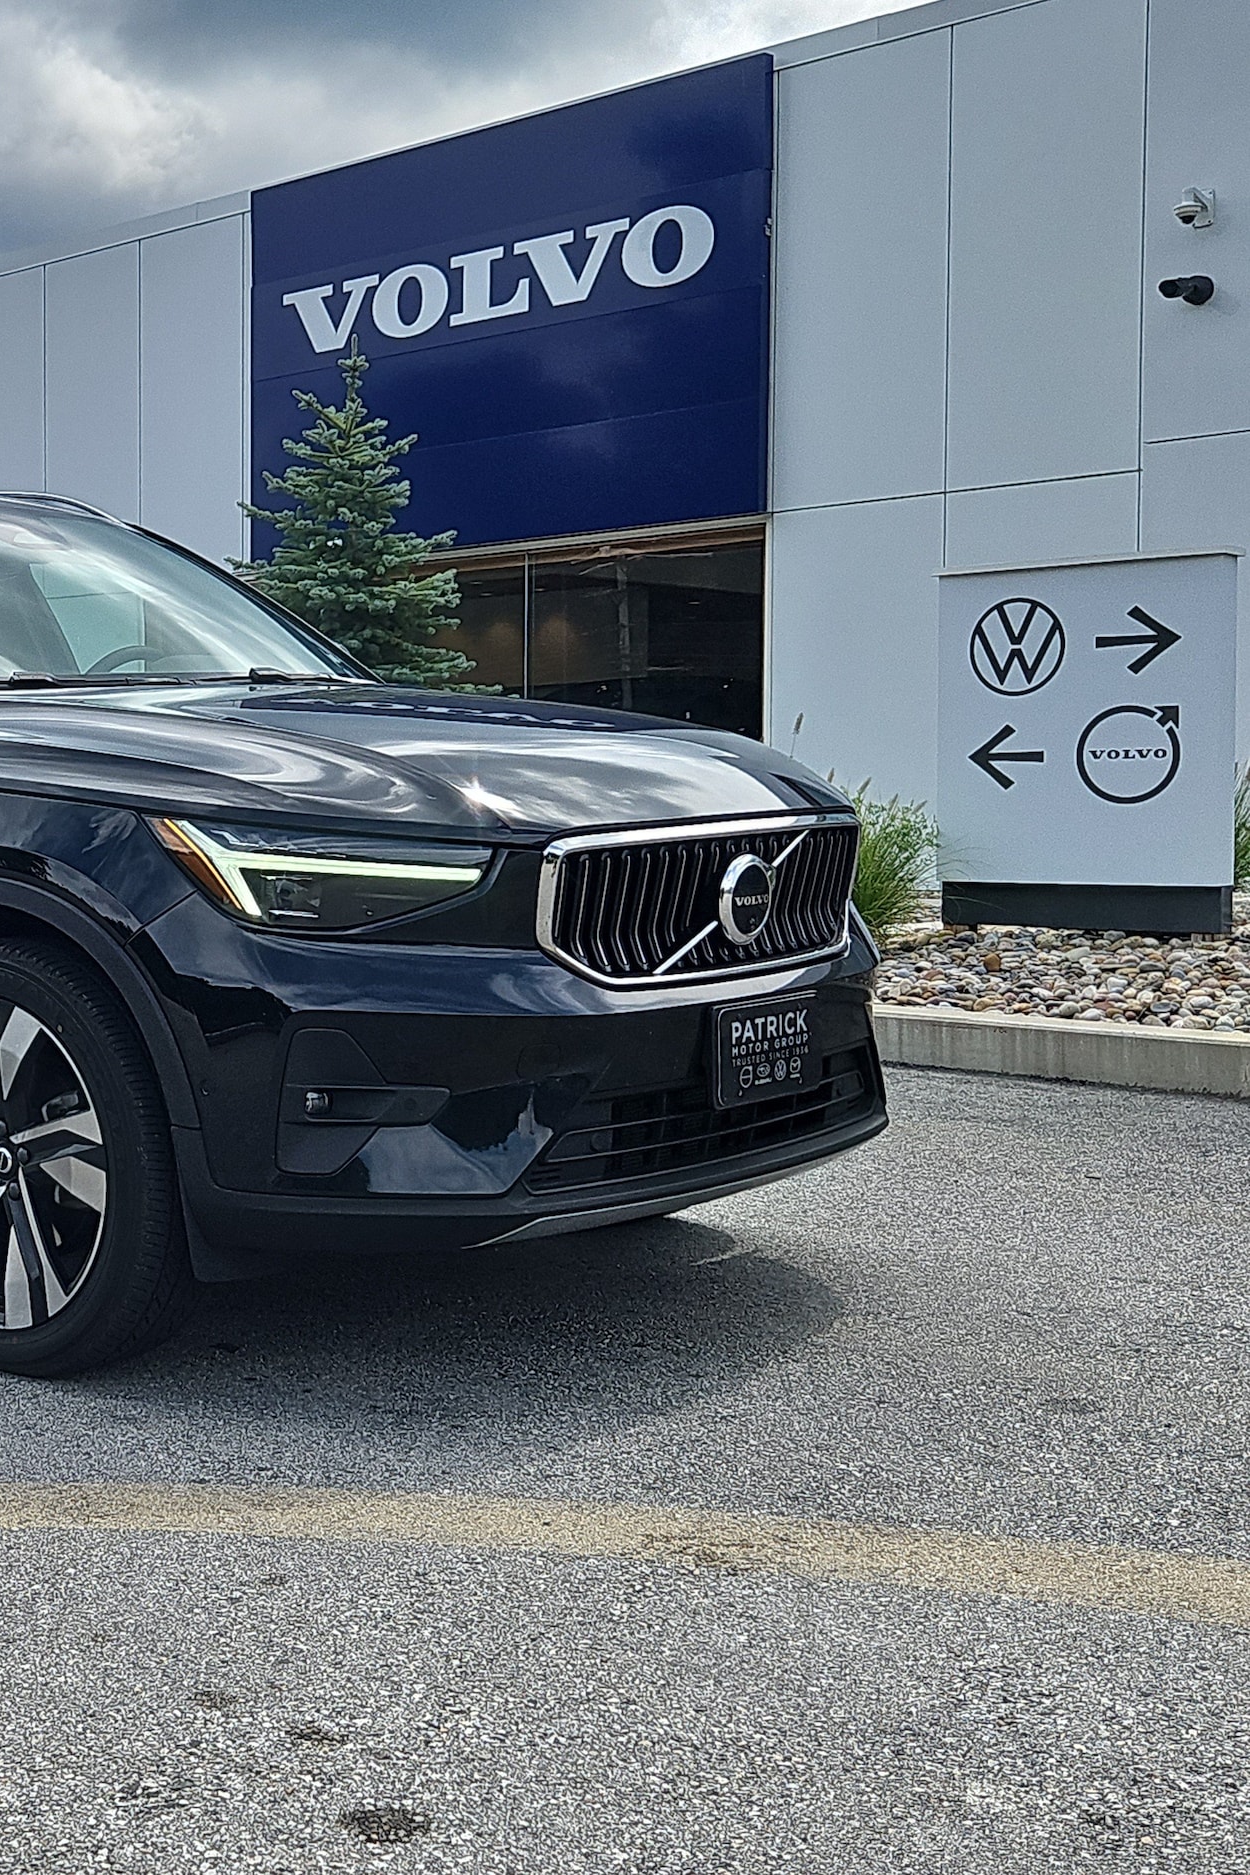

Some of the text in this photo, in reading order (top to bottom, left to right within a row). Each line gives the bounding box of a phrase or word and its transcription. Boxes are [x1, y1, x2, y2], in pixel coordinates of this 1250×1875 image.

[282, 205, 715, 353] VOLVO
[1088, 748, 1168, 760] VOLVO
[734, 893, 769, 907] VOLVO
[731, 1008, 808, 1045] PATRICK
[731, 1033, 809, 1057] MOTOR GROUP
[732, 1053, 766, 1067] TRUSTED
[769, 1048, 790, 1061] SINCE
